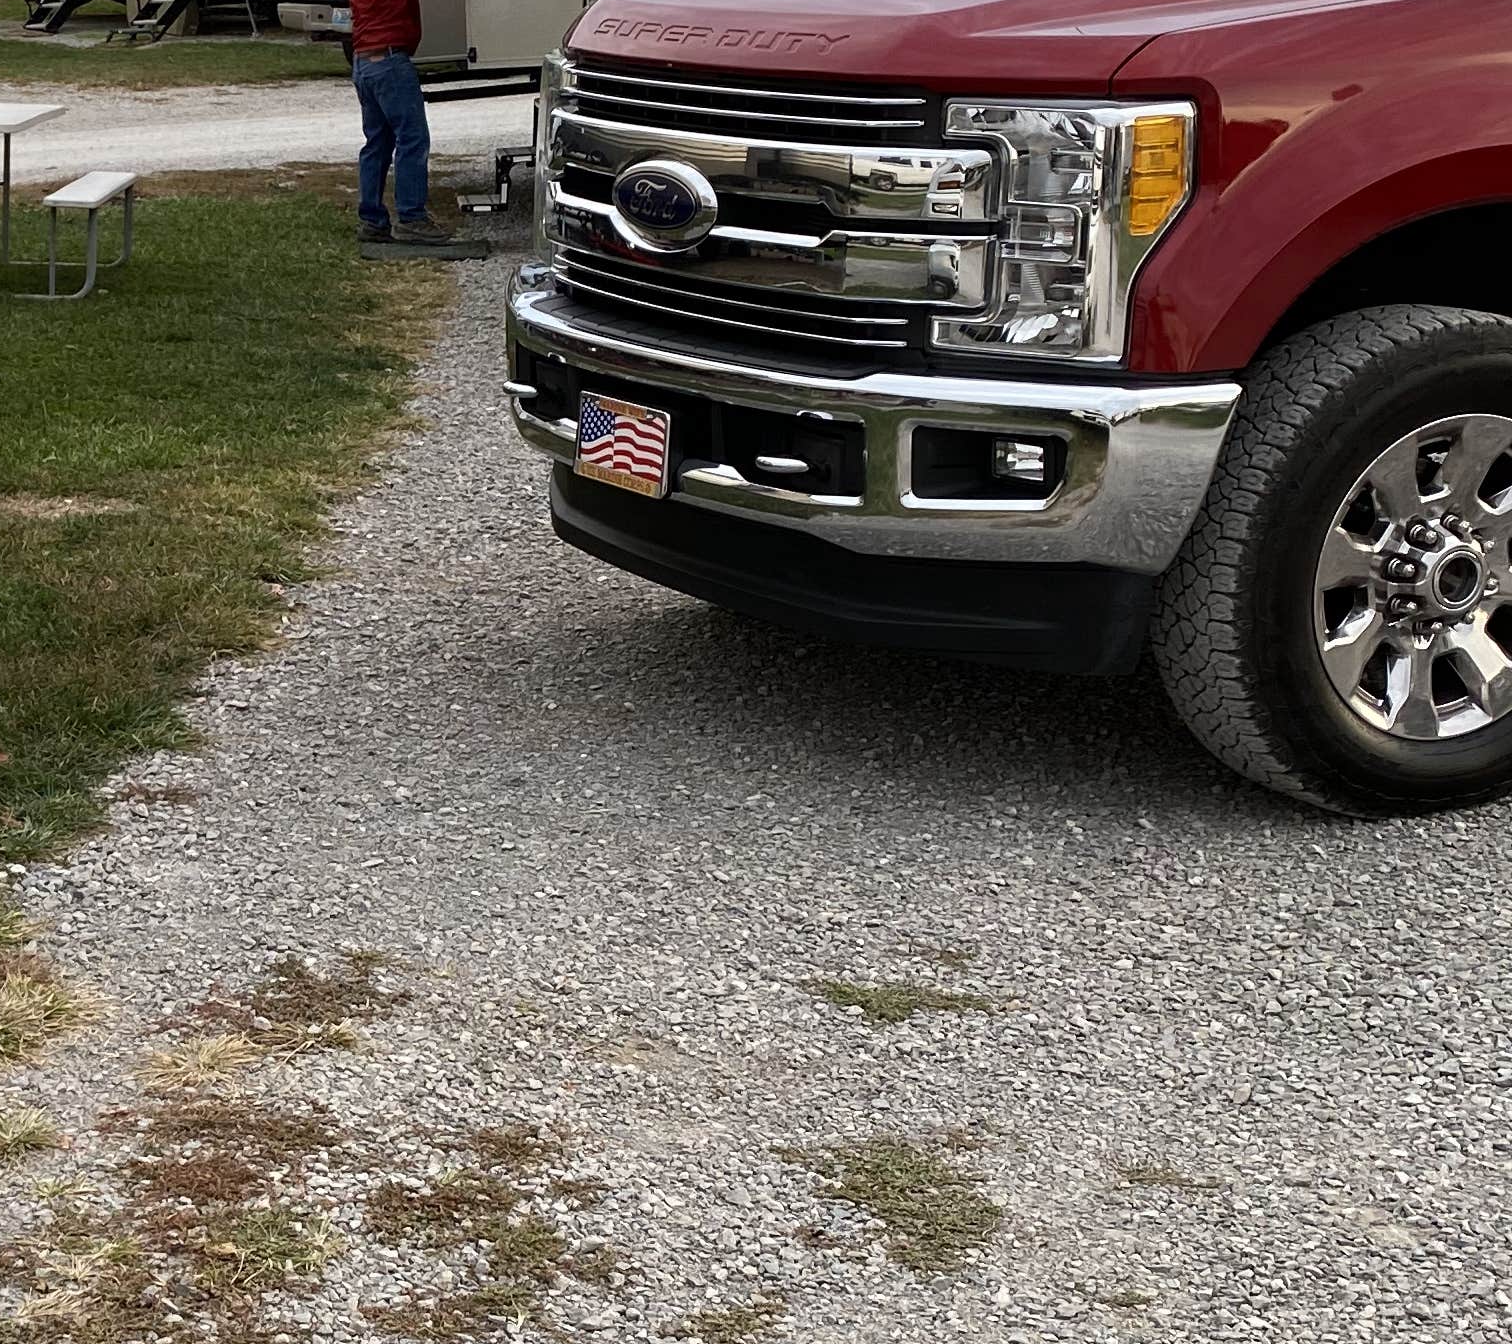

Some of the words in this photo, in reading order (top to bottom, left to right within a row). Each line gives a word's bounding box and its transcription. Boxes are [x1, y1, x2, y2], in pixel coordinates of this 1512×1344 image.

[593, 18, 714, 46] SUPER
[715, 28, 850, 56] DUTY
[630, 179, 679, 220] Ford
